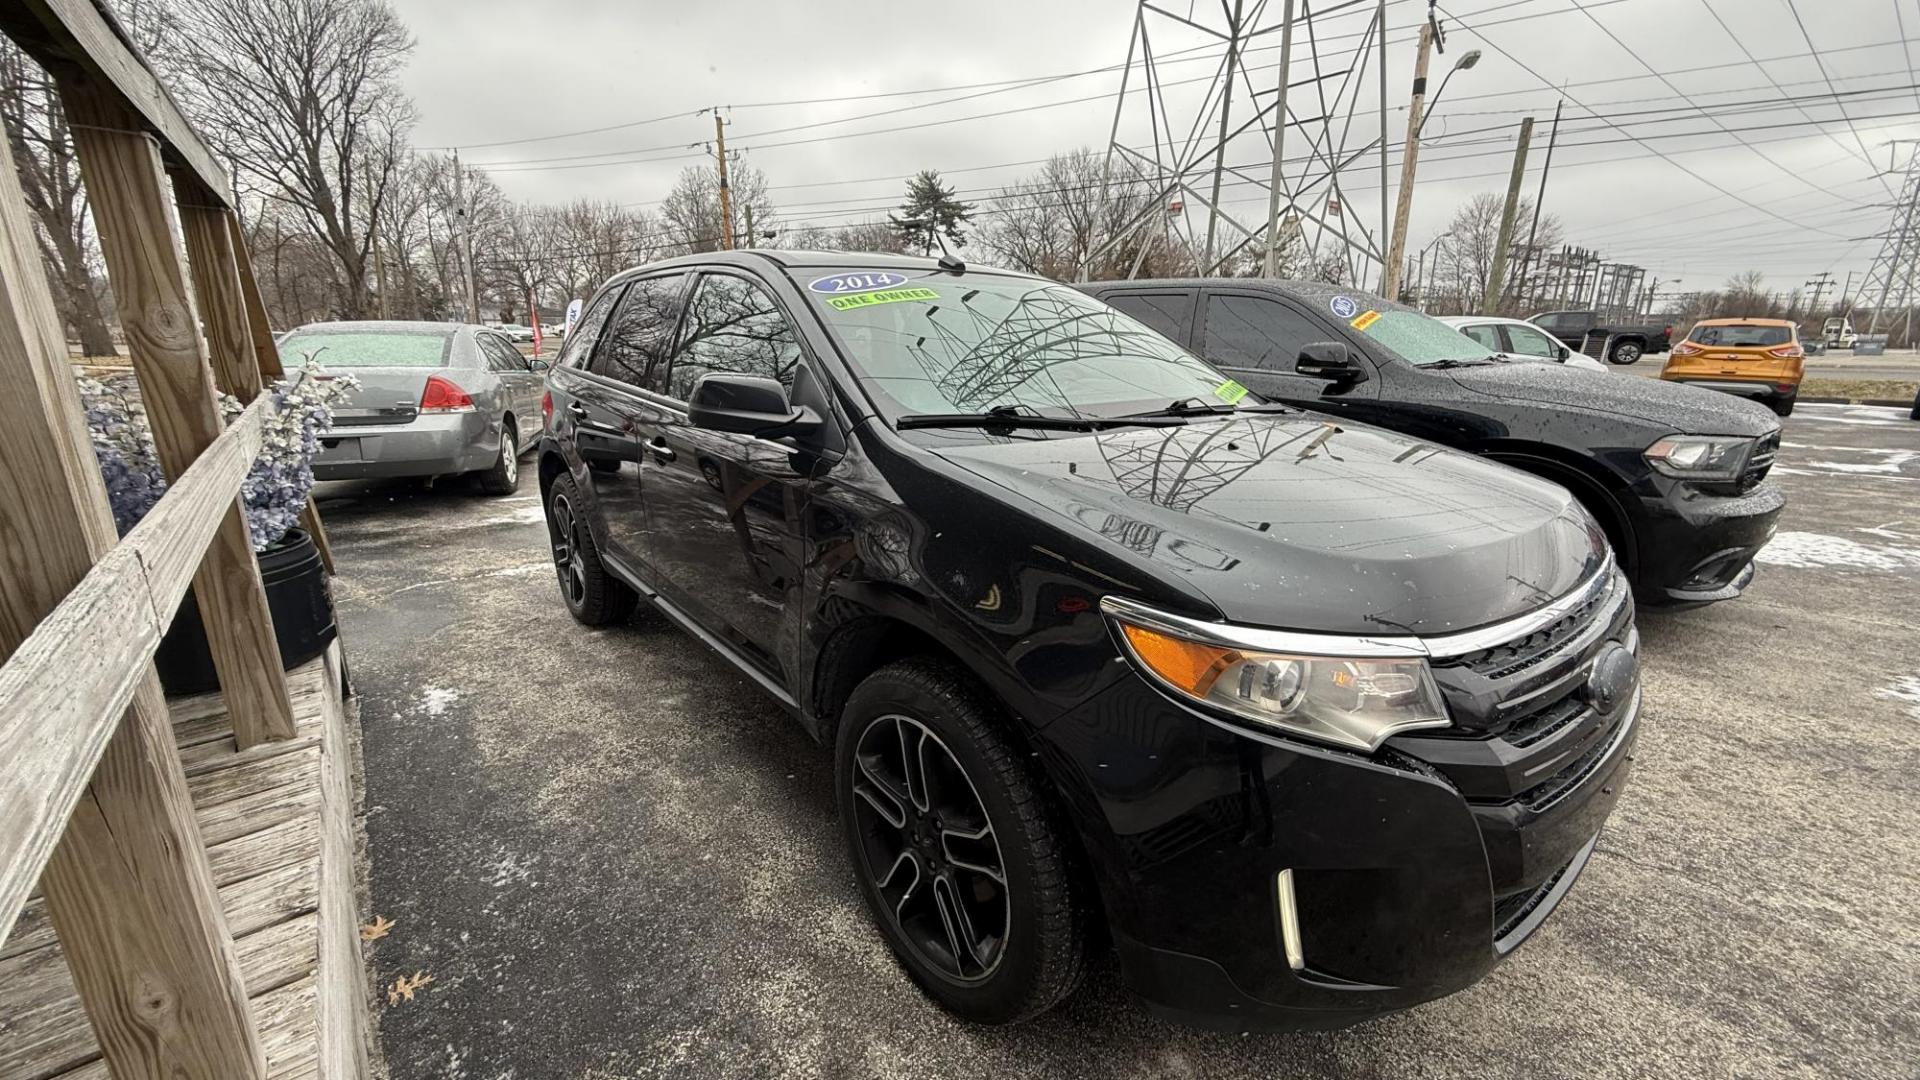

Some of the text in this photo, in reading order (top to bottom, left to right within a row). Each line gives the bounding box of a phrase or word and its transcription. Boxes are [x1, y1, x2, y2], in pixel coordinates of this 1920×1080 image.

[830, 273, 891, 291] 2014
[832, 289, 934, 308] ONE OWNER
